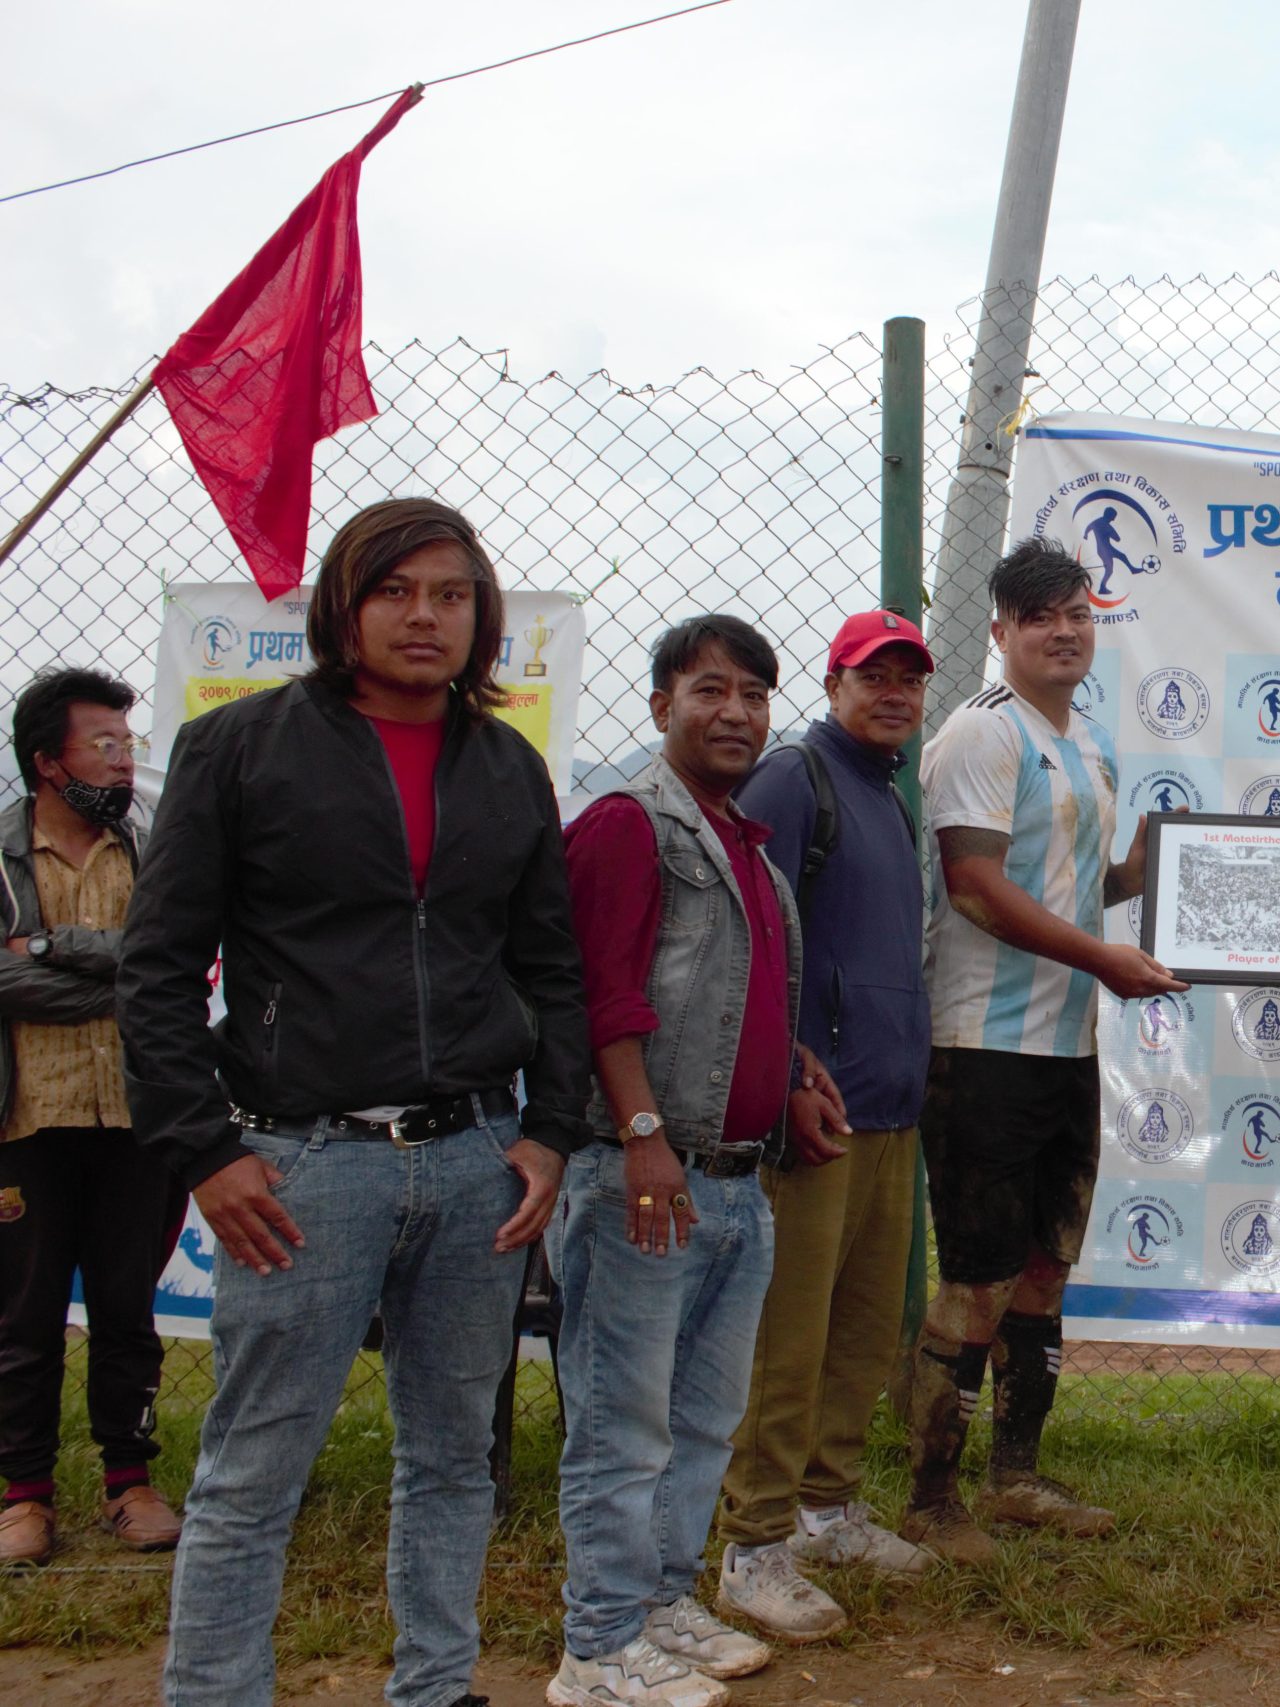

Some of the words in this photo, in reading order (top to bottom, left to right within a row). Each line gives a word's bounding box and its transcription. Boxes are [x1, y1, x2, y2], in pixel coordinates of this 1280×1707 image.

[1104, 471, 1131, 484] तथा
[1134, 475, 1171, 511] विकास
[1166, 512, 1187, 554] समिति
[245, 631, 306, 669] प्रथम
[1204, 832, 1219, 842] 1st
[1227, 953, 1264, 965] Player
[1267, 954, 1280, 964] of
